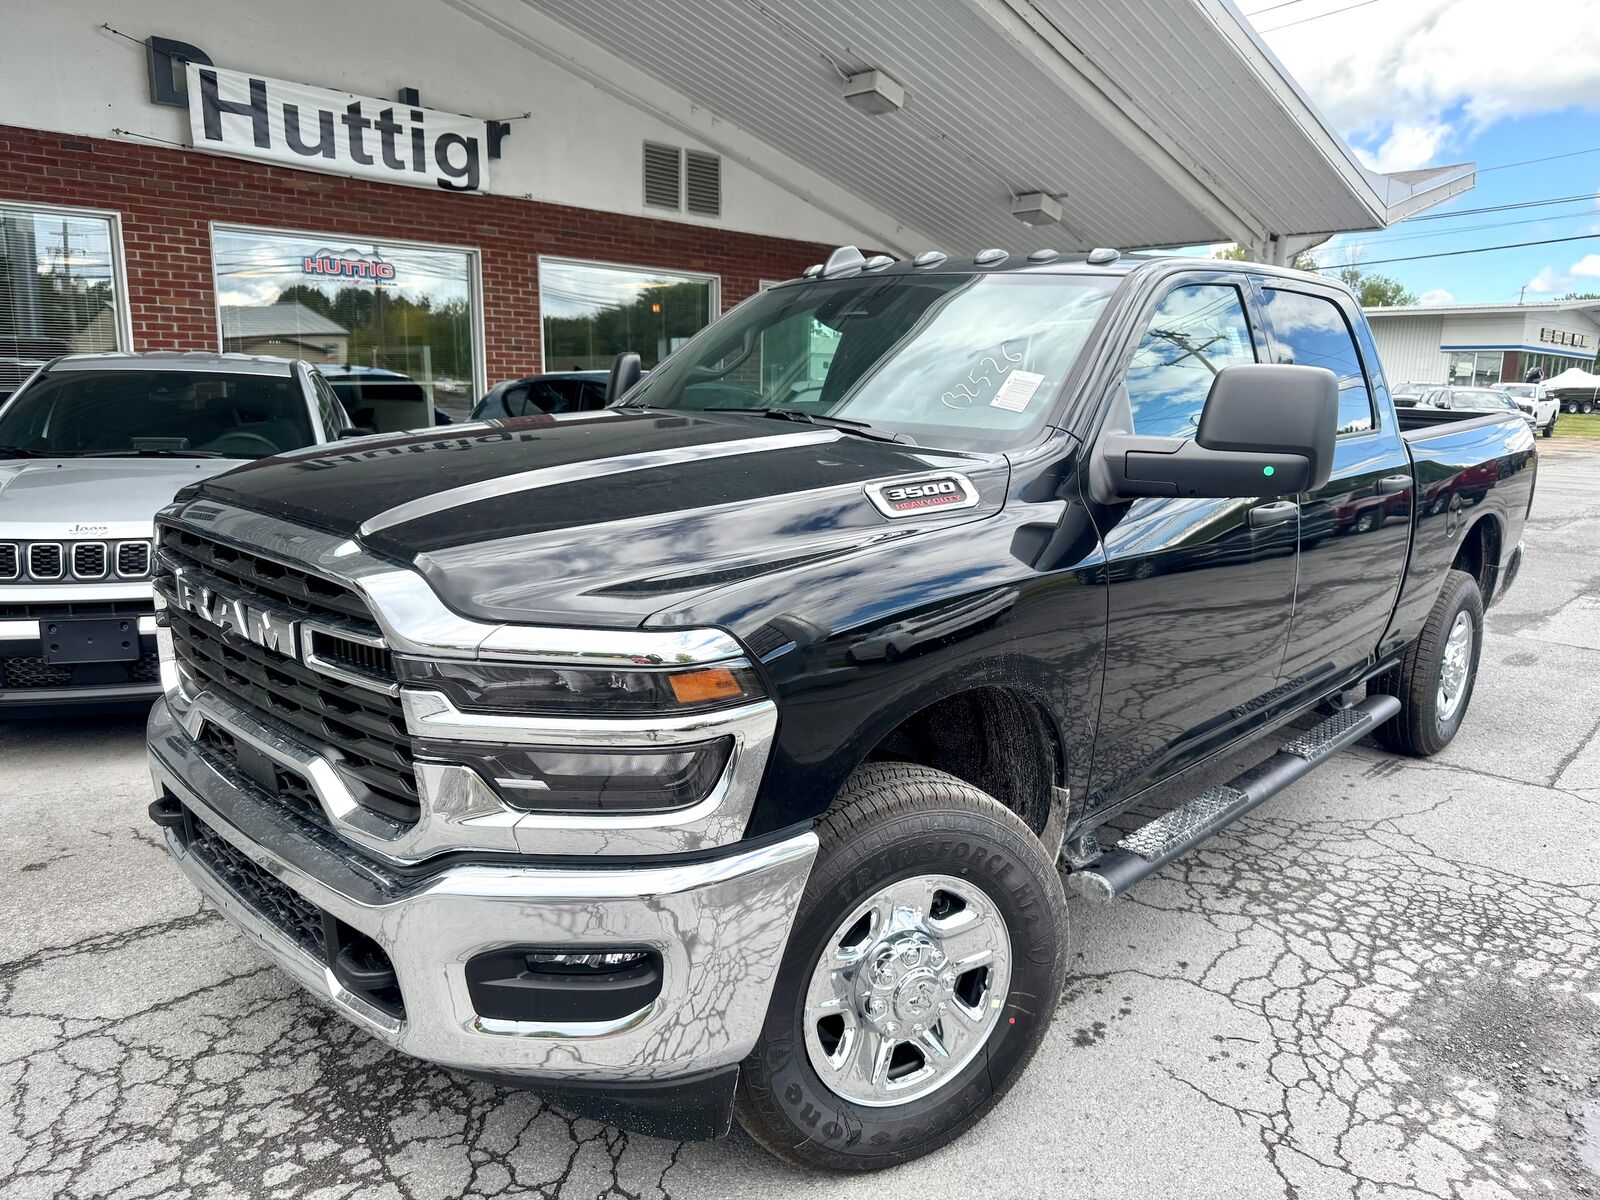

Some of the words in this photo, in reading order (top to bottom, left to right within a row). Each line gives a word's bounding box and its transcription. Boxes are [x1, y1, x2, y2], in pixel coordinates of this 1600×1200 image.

[199, 68, 479, 191] Huttig
[304, 257, 396, 278] HUTTIG
[888, 482, 956, 500] 3500
[895, 499, 931, 510] HEAVY
[933, 495, 961, 504] DUTY
[69, 524, 108, 537] Jeep
[175, 570, 302, 660] RAM
